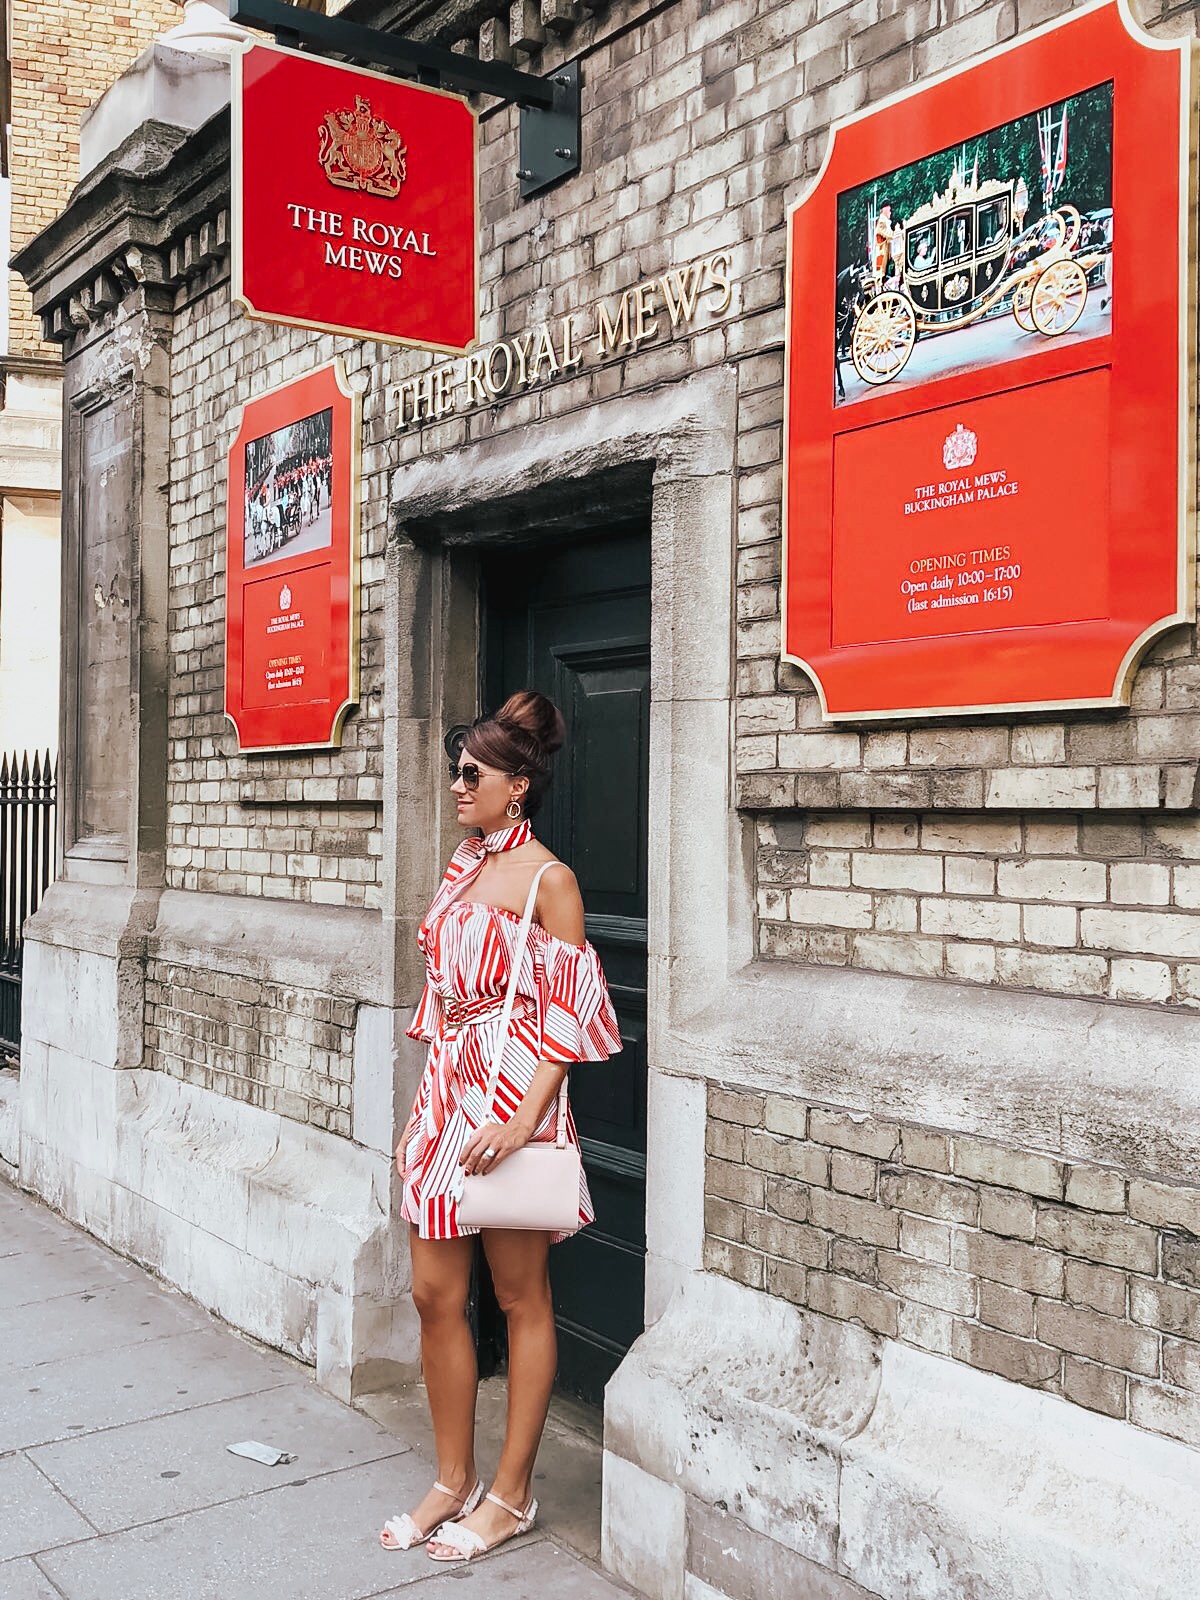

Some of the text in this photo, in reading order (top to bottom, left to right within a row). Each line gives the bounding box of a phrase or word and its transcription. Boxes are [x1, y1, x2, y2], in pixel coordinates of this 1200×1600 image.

[287, 203, 437, 256] THE ROYAL
[324, 242, 402, 278] MEWS
[392, 254, 732, 429] THE ROYAL MEWS
[904, 482, 1019, 515] BUCKINGHAM PALACE
[914, 470, 1007, 499] THE ROYAL MEWS
[910, 546, 1011, 574] OPENING TIMES
[901, 580, 928, 595] Open
[930, 575, 954, 591] daily
[907, 586, 1013, 613] (last admission 16:15)
